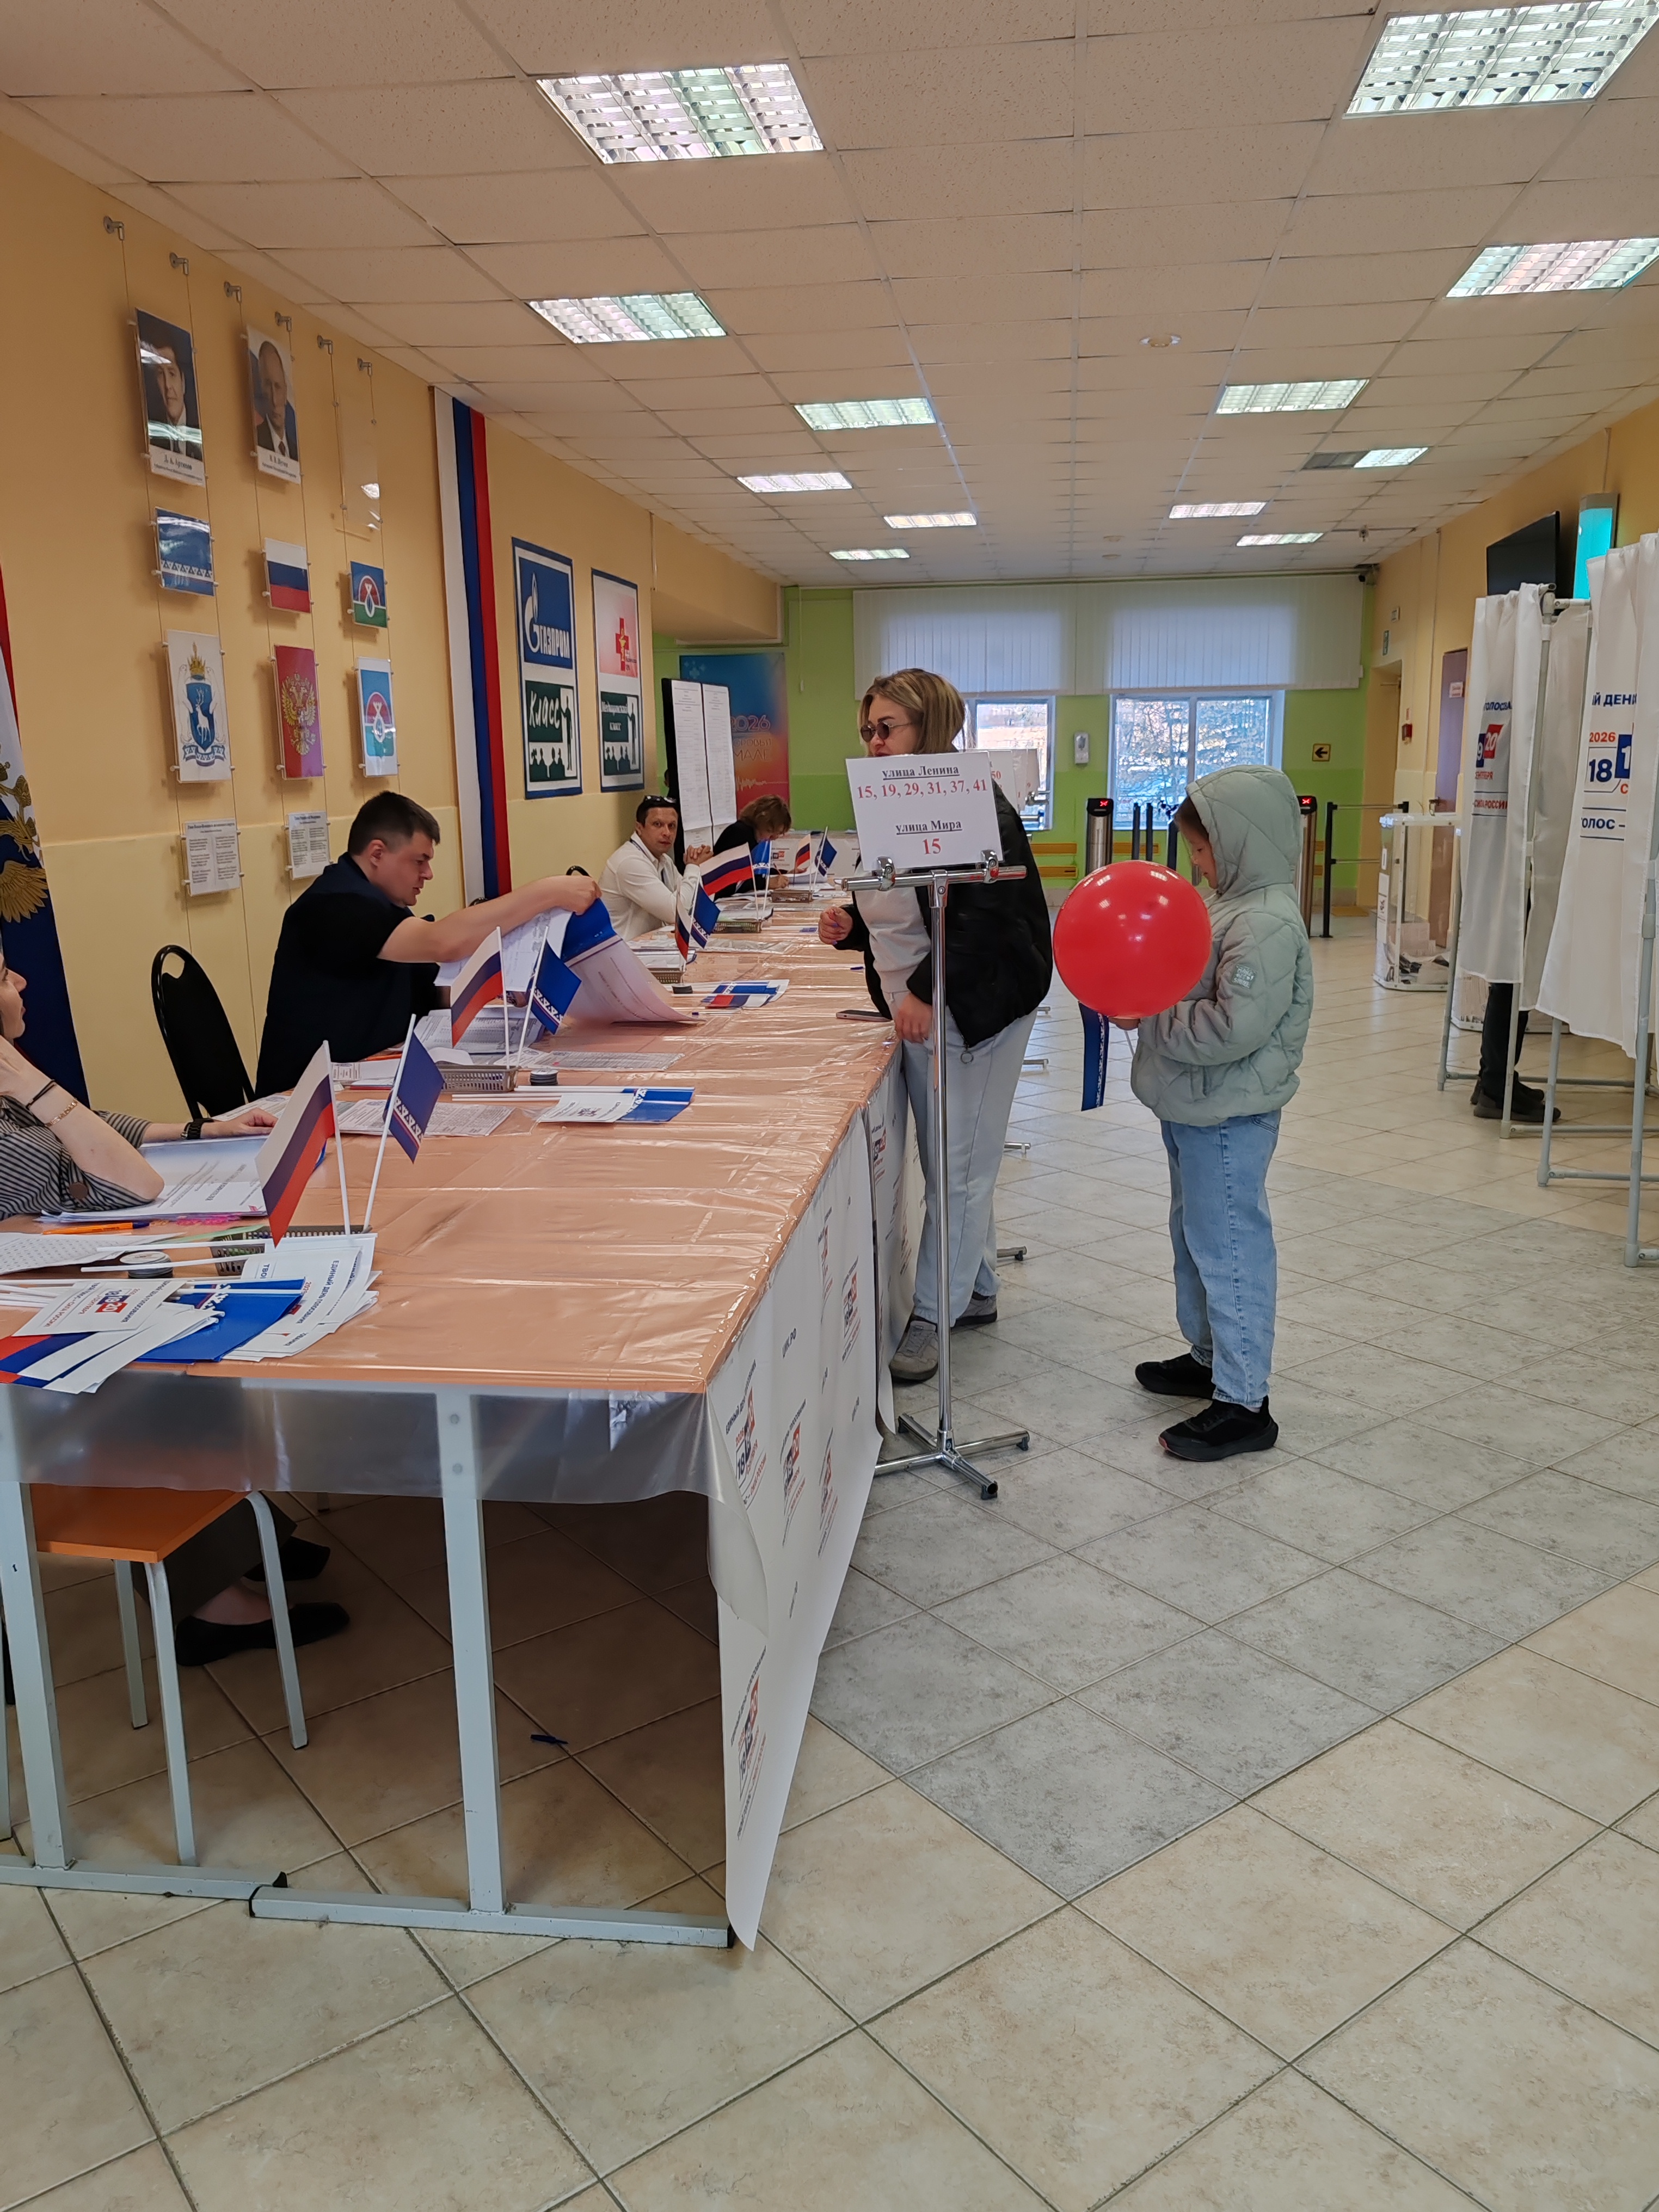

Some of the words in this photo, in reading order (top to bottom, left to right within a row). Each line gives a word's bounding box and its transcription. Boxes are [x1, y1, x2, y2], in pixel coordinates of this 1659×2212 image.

[539, 625, 570, 659] ГАЗПРОМ
[529, 690, 561, 729] Класс
[733, 738, 771, 747] ОРОВЬЯ
[1485, 732, 1497, 751] 20
[1589, 732, 1616, 742] 2026
[733, 749, 768, 761] МАЛЕ
[882, 769, 915, 778] улица
[918, 766, 959, 776] Ленина
[1589, 759, 1613, 783] 18
[857, 786, 877, 800] 15,
[882, 784, 901, 798] 19,
[904, 782, 924, 797] 29,
[927, 781, 947, 796] 31,
[950, 780, 970, 795] 37,
[973, 779, 987, 791] 41
[895, 823, 927, 833] улица
[931, 820, 962, 832] Мира
[1582, 818, 1615, 830] ОЛОС
[922, 838, 942, 855] 15
[325, 1260, 339, 1286] ЕДИНЫЙ
[105, 1289, 122, 1297] 18
[107, 1295, 123, 1303] 19
[319, 1286, 329, 1300] ДЕНЬ
[102, 1302, 122, 1312] 20
[120, 1295, 150, 1323] ГОЛОСОВАНИЯ
[296, 1298, 323, 1324] ГОЛОСОВАНИЯ
[737, 1452, 745, 1480] 18
[741, 1751, 746, 1780] 18
